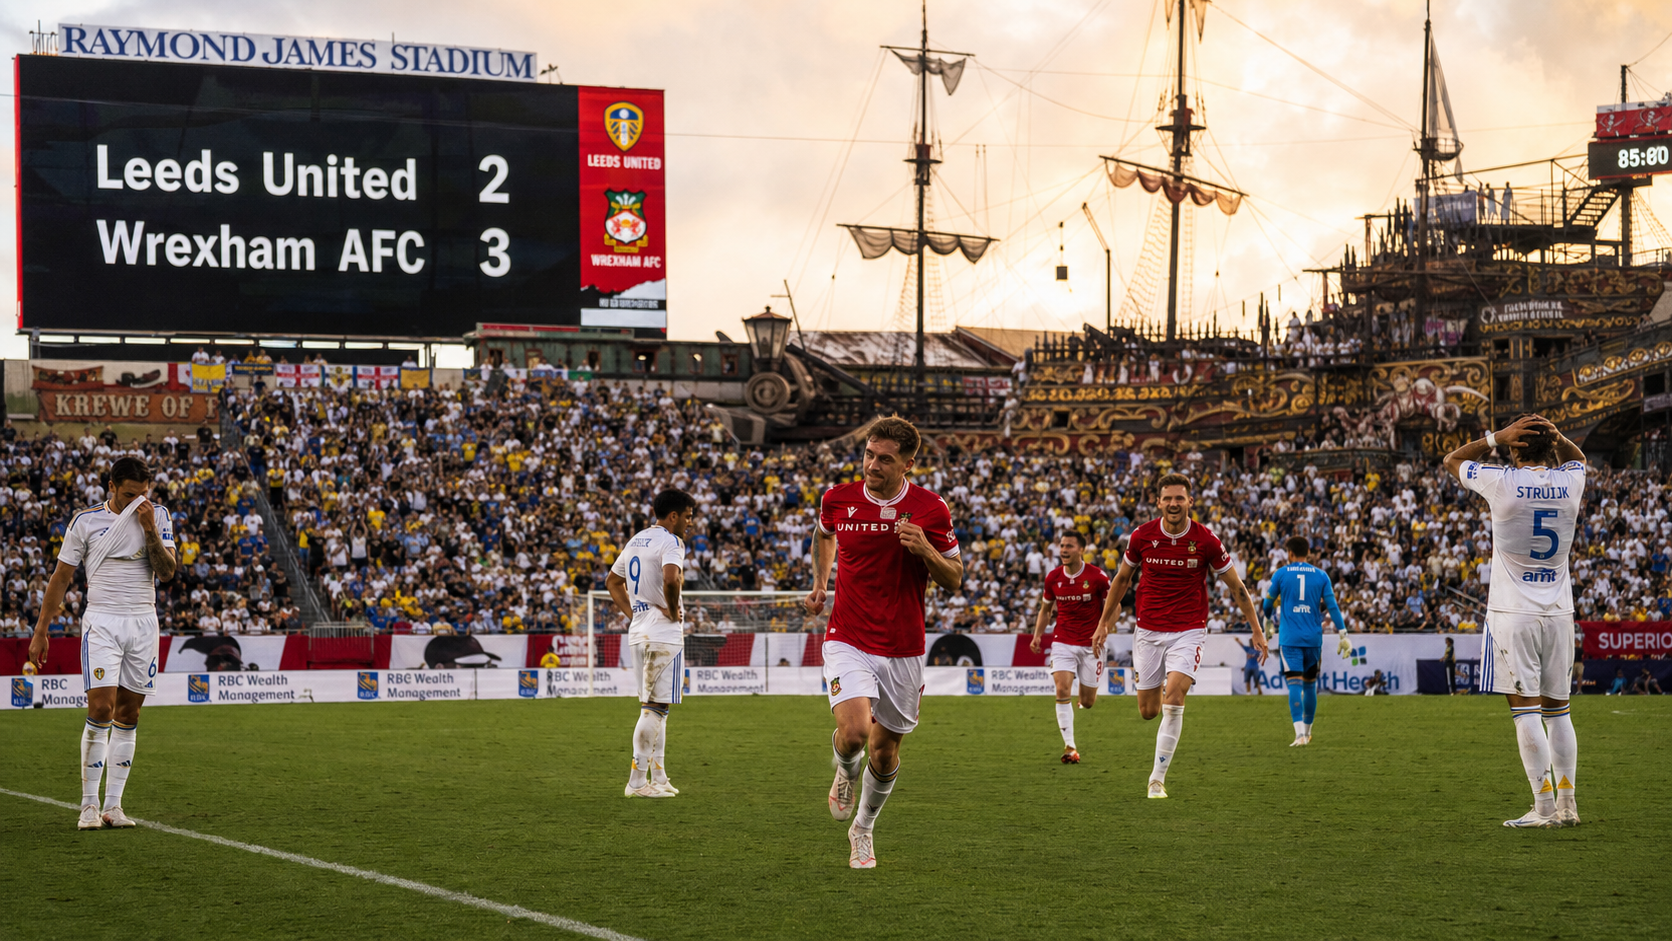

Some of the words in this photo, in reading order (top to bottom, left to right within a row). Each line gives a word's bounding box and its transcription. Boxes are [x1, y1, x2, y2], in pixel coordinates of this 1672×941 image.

[62, 26, 256, 63] RAYMOND
[262, 37, 377, 69] JAMES
[391, 44, 535, 79] STADIUM
[587, 154, 621, 168] LEEDS
[623, 156, 662, 170] UNITED
[97, 144, 240, 194] Leeds
[263, 152, 417, 201] United
[478, 154, 510, 204] 2
[96, 219, 316, 270] Wrexham
[338, 228, 425, 274] AFC
[479, 227, 511, 277] 3
[590, 254, 641, 267] WREXHAM
[643, 256, 662, 268] AFC
[55, 393, 149, 418] KREWE
[161, 396, 193, 418] OF
[1516, 486, 1570, 499] STRUIJK
[837, 523, 889, 531] UNITED
[1529, 510, 1559, 560] 5
[1146, 557, 1184, 566] UNITED
[629, 556, 641, 595] 9
[1297, 574, 1306, 601] 1
[1598, 632, 1672, 649] SUPERIO
[148, 657, 157, 678] 6
[218, 675, 243, 686] RBC
[247, 674, 288, 685] Wealth
[387, 673, 411, 684] RBC
[414, 673, 454, 684] Wealth
[697, 670, 719, 680] RBC
[722, 670, 758, 680] Wealth
[991, 670, 1013, 680] RBC
[1015, 670, 1049, 680] Wealth
[42, 679, 68, 690] RBC
[991, 683, 1055, 696] Management
[218, 690, 295, 704] Management
[387, 688, 461, 701] Management
